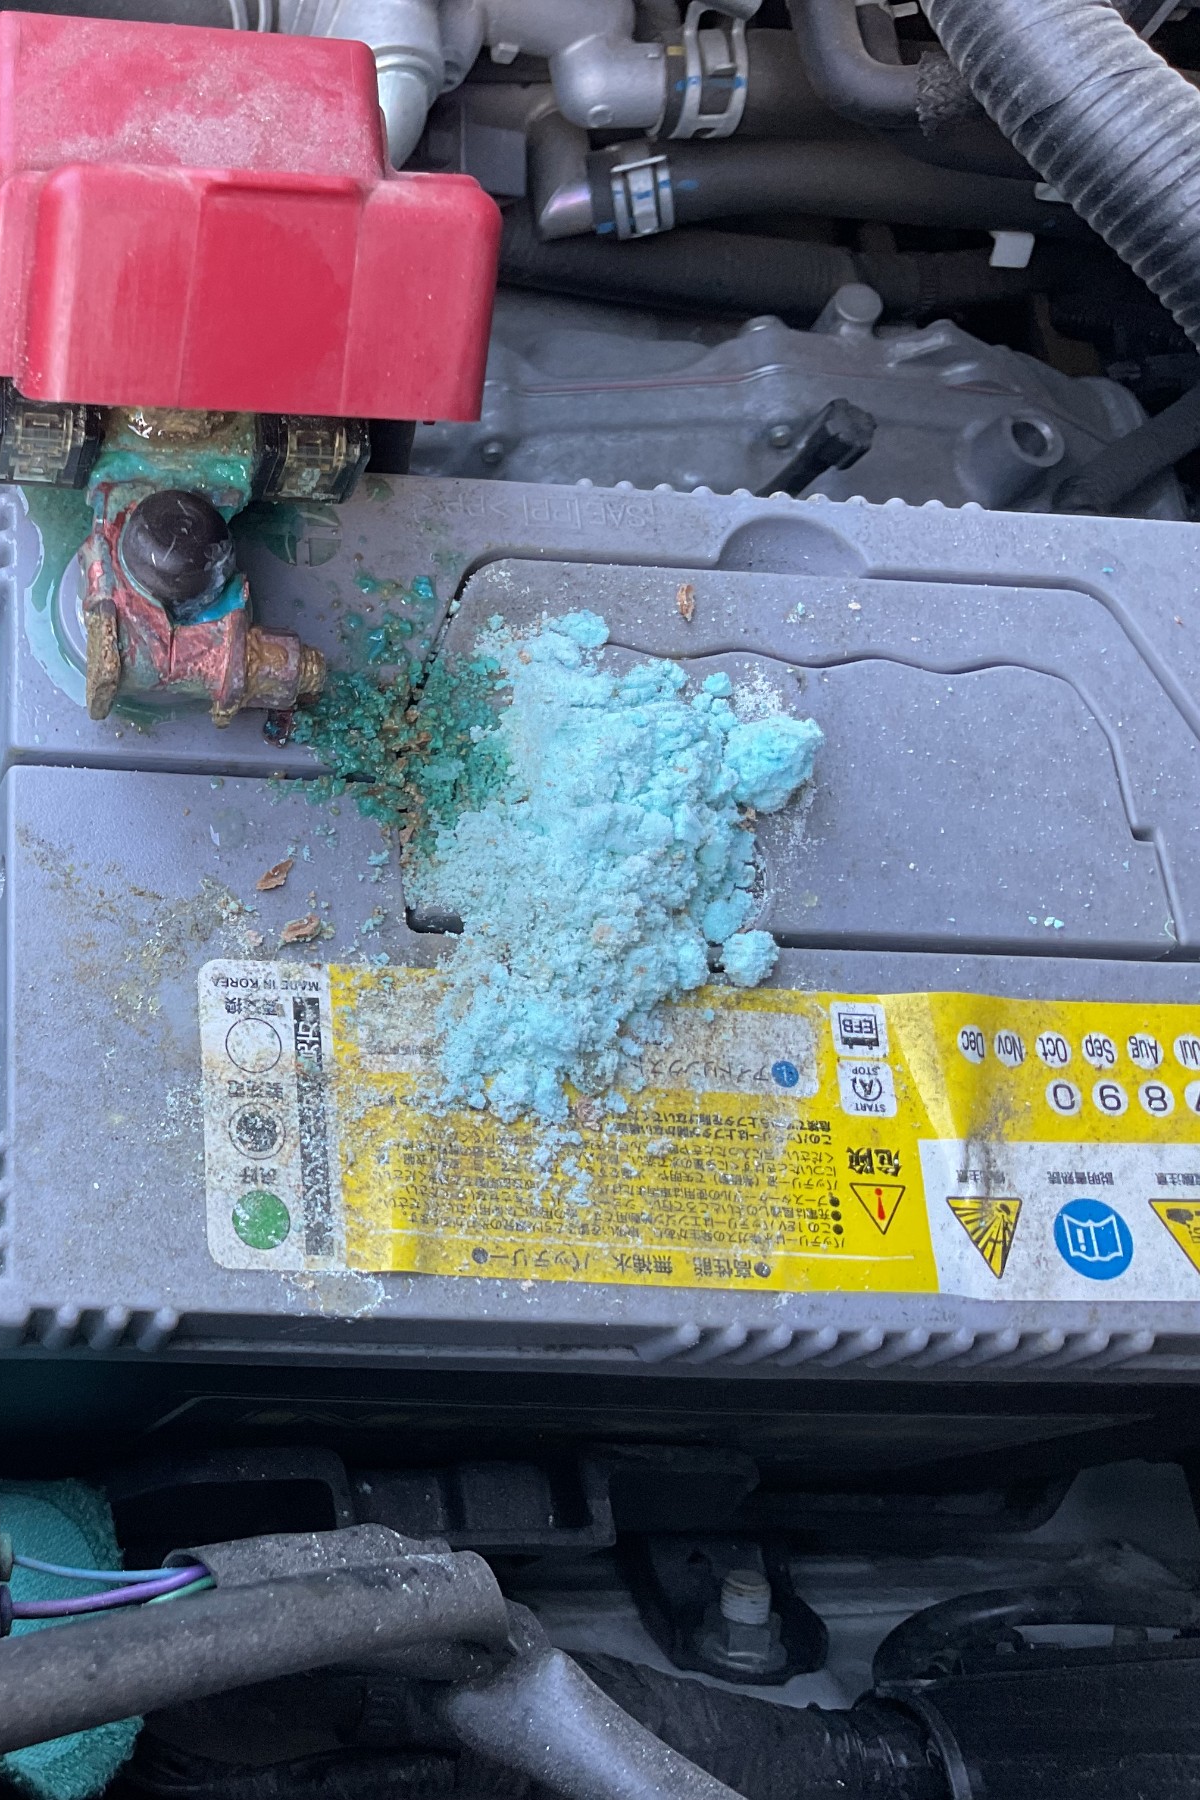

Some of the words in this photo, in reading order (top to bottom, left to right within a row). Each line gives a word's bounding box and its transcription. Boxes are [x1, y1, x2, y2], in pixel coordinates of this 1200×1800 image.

[211, 977, 258, 989] KOREA
[263, 980, 275, 990] IN
[280, 980, 318, 992] MADE
[842, 1019, 873, 1034] EFB
[960, 1029, 984, 1058] Dec
[997, 1035, 1023, 1062] Nov
[1038, 1037, 1067, 1063] Oct
[1085, 1035, 1115, 1063] Sep
[1128, 1036, 1158, 1064] Aug
[1179, 1040, 1200, 1066] Jul
[618, 1056, 769, 1085] アイドリングスト
[852, 1066, 878, 1075] STOP
[855, 1103, 886, 1112] START
[1052, 1084, 1075, 1110] 0
[1099, 1085, 1122, 1111] 9
[1144, 1086, 1168, 1112] 8
[846, 1147, 901, 1177] 危険
[1047, 1171, 1114, 1185] 説明書熟読
[489, 1247, 591, 1271] バッテリー
[613, 1253, 673, 1275] 無補水
[694, 1258, 753, 1279] 高性能
